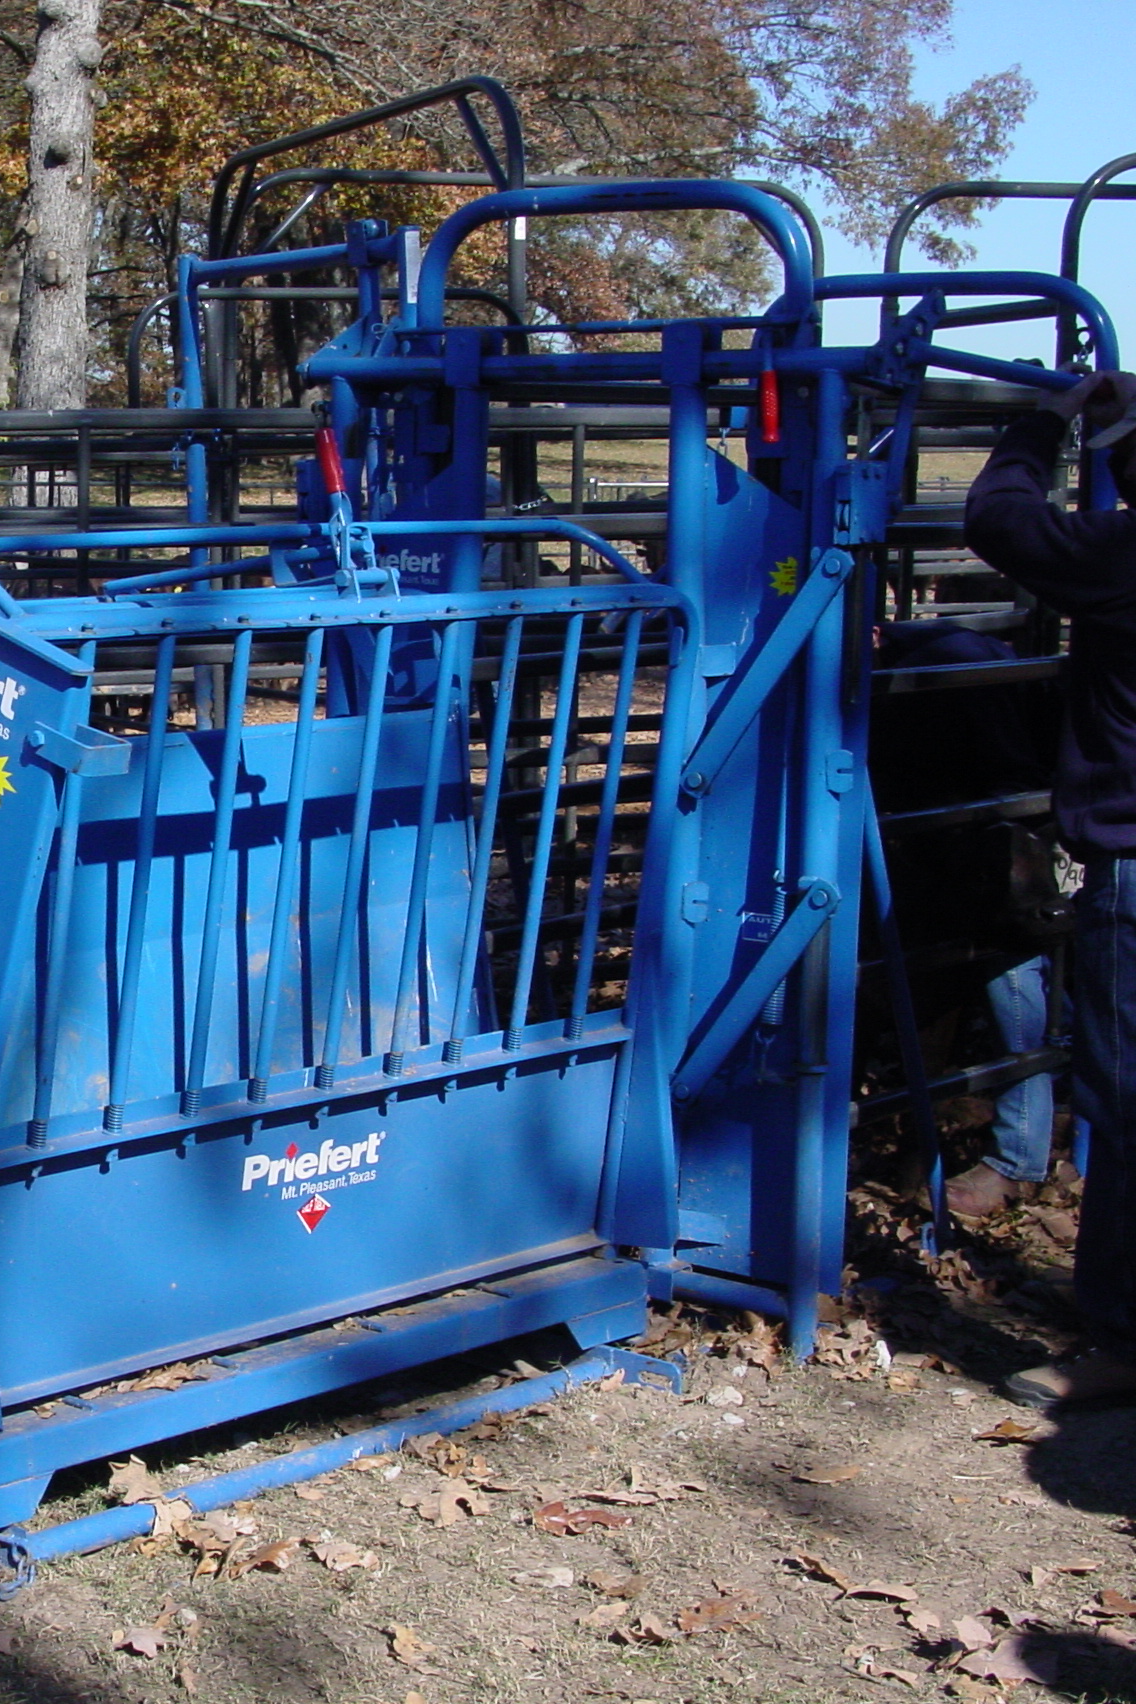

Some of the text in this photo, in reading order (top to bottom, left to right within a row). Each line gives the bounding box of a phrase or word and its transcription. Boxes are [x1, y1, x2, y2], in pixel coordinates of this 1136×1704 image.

[281, 1169, 377, 1200] Mt. Pleasant, Texas
